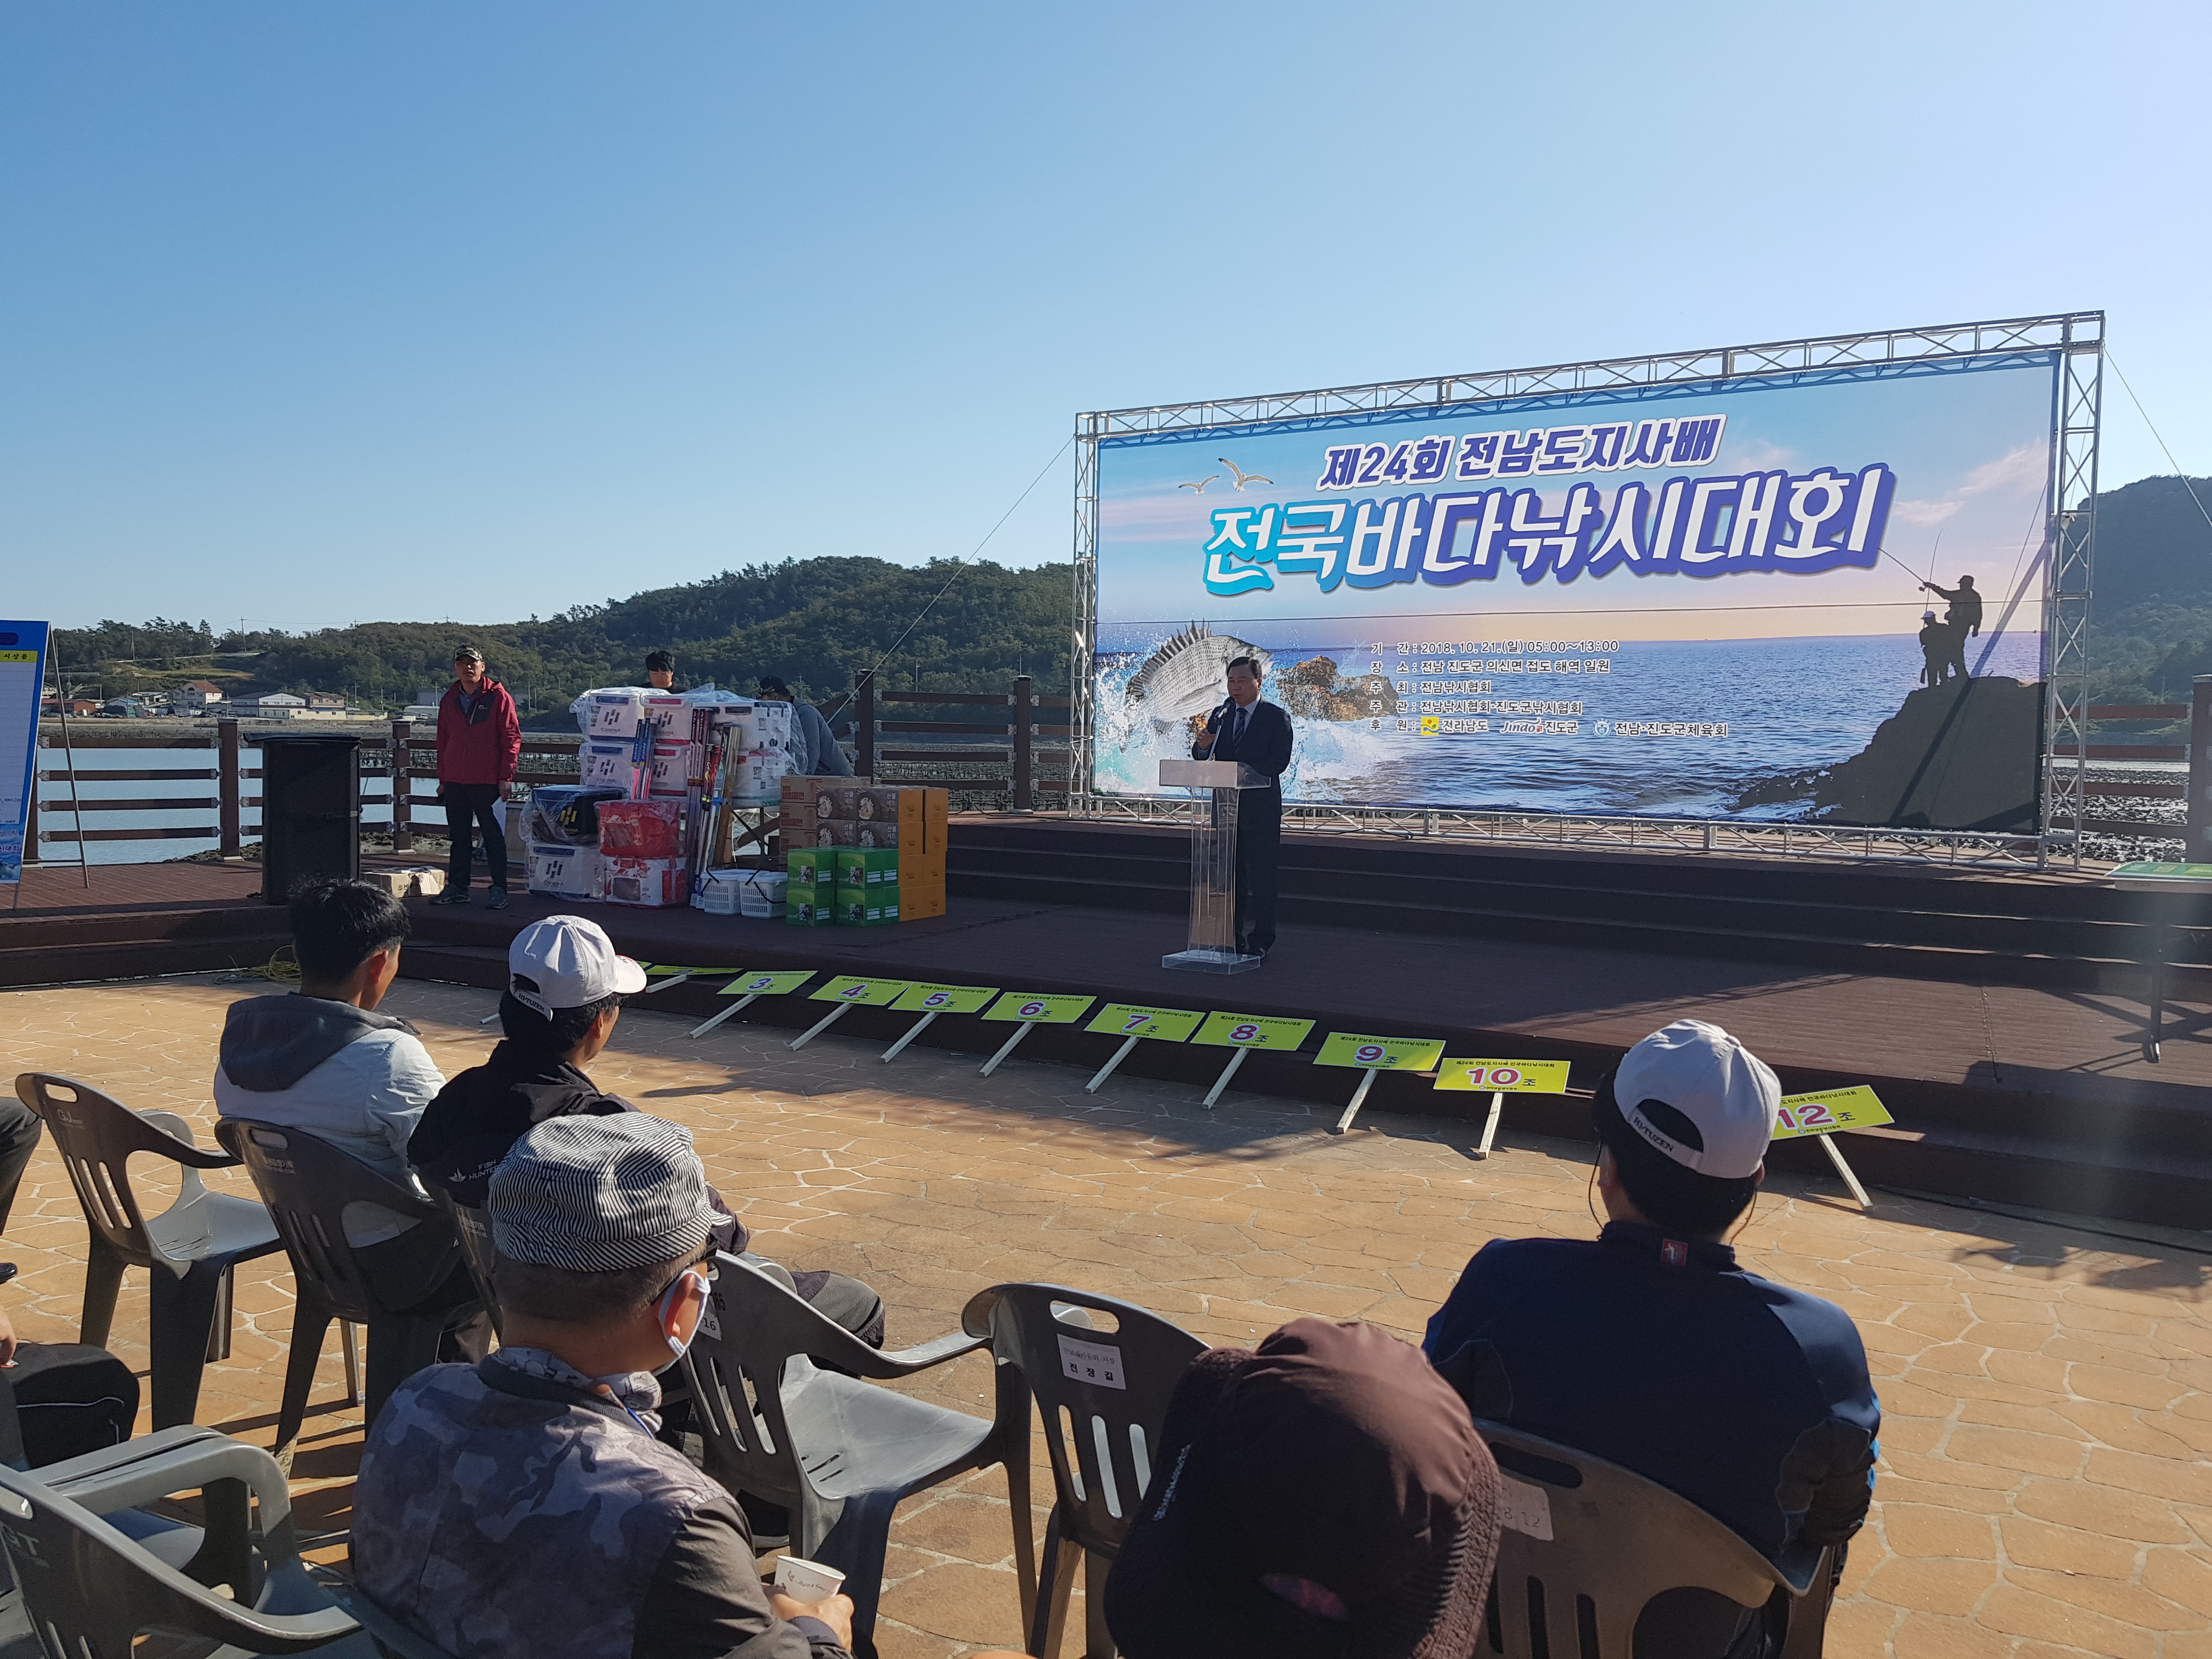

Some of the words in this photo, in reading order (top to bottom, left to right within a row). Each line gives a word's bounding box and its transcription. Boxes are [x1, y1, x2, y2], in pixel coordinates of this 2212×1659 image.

[1318, 438, 1453, 488] 제24회
[1458, 417, 1722, 478] 전남도지사배
[1205, 465, 1887, 590] 전국바다낚시대회
[1421, 642, 1455, 653] 2018.
[1459, 642, 1477, 653] 10.
[1482, 640, 1523, 653] 21.(일)
[1527, 640, 1618, 652] 05:00~13:00
[1421, 661, 1444, 673] 전남
[1448, 661, 1482, 673] 진도군
[1487, 660, 1522, 673] 의신면
[1527, 660, 1551, 672] 접도
[1555, 660, 1579, 673] 해역
[1585, 660, 1609, 673] 일원
[1421, 681, 1491, 693] 전남낚시협회
[1443, 720, 1488, 732] 전라남도
[1546, 721, 1578, 733] 진도군
[478, 1159, 496, 1171] FISH
